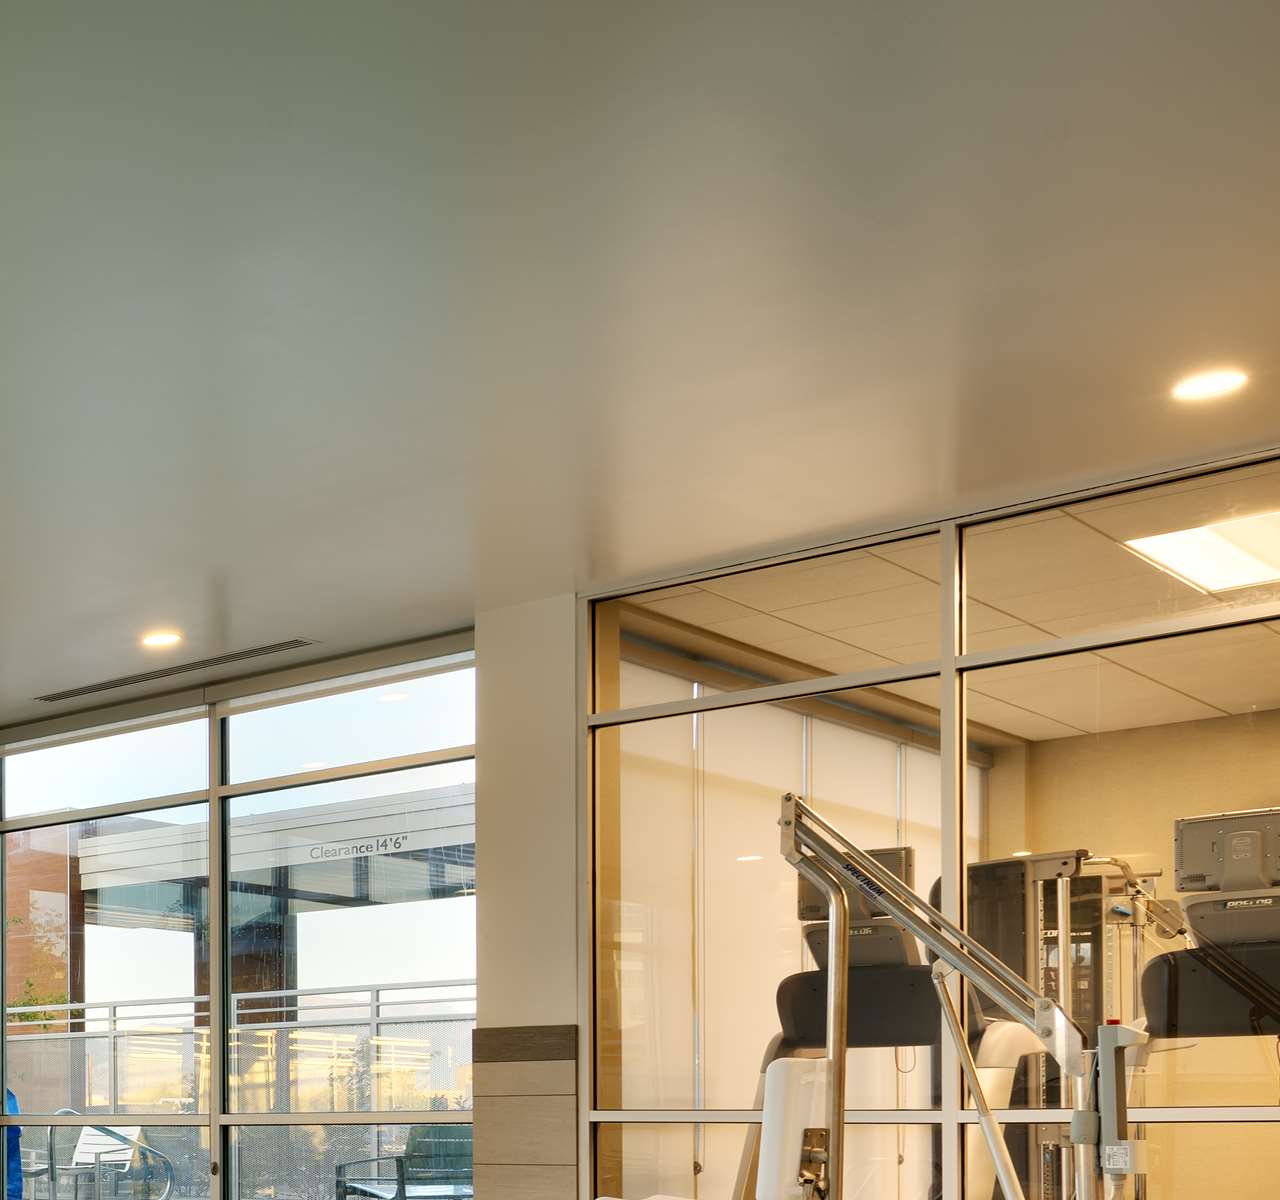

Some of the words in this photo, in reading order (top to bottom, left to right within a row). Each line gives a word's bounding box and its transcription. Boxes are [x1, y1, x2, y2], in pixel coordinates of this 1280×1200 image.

[310, 845, 373, 860] Clearance
[376, 835, 408, 851] 14'6"
[842, 863, 885, 897] SPECTRUM
